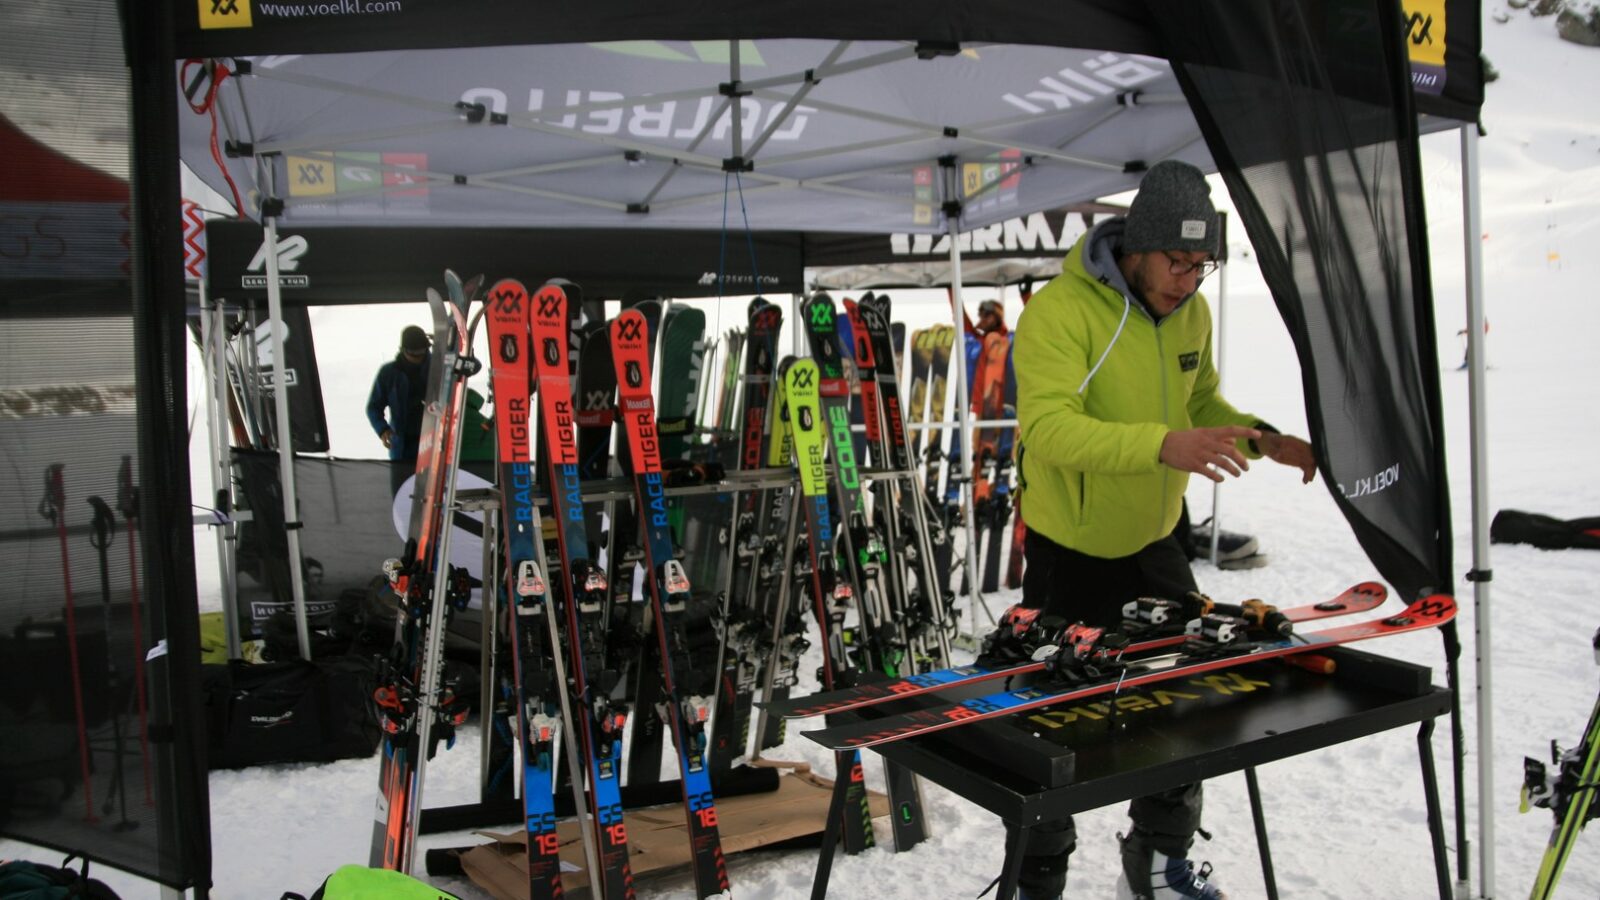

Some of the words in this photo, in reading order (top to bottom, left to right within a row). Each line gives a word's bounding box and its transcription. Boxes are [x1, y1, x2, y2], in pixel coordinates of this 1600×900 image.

[259, 0, 402, 17] www.voelkl.com
[829, 406, 859, 489] CODE
[688, 792, 714, 810] GS
[528, 812, 555, 832] GS
[599, 803, 623, 825] GS
[696, 807, 718, 828] 18
[535, 833, 559, 855] 19
[606, 824, 627, 845] 19
